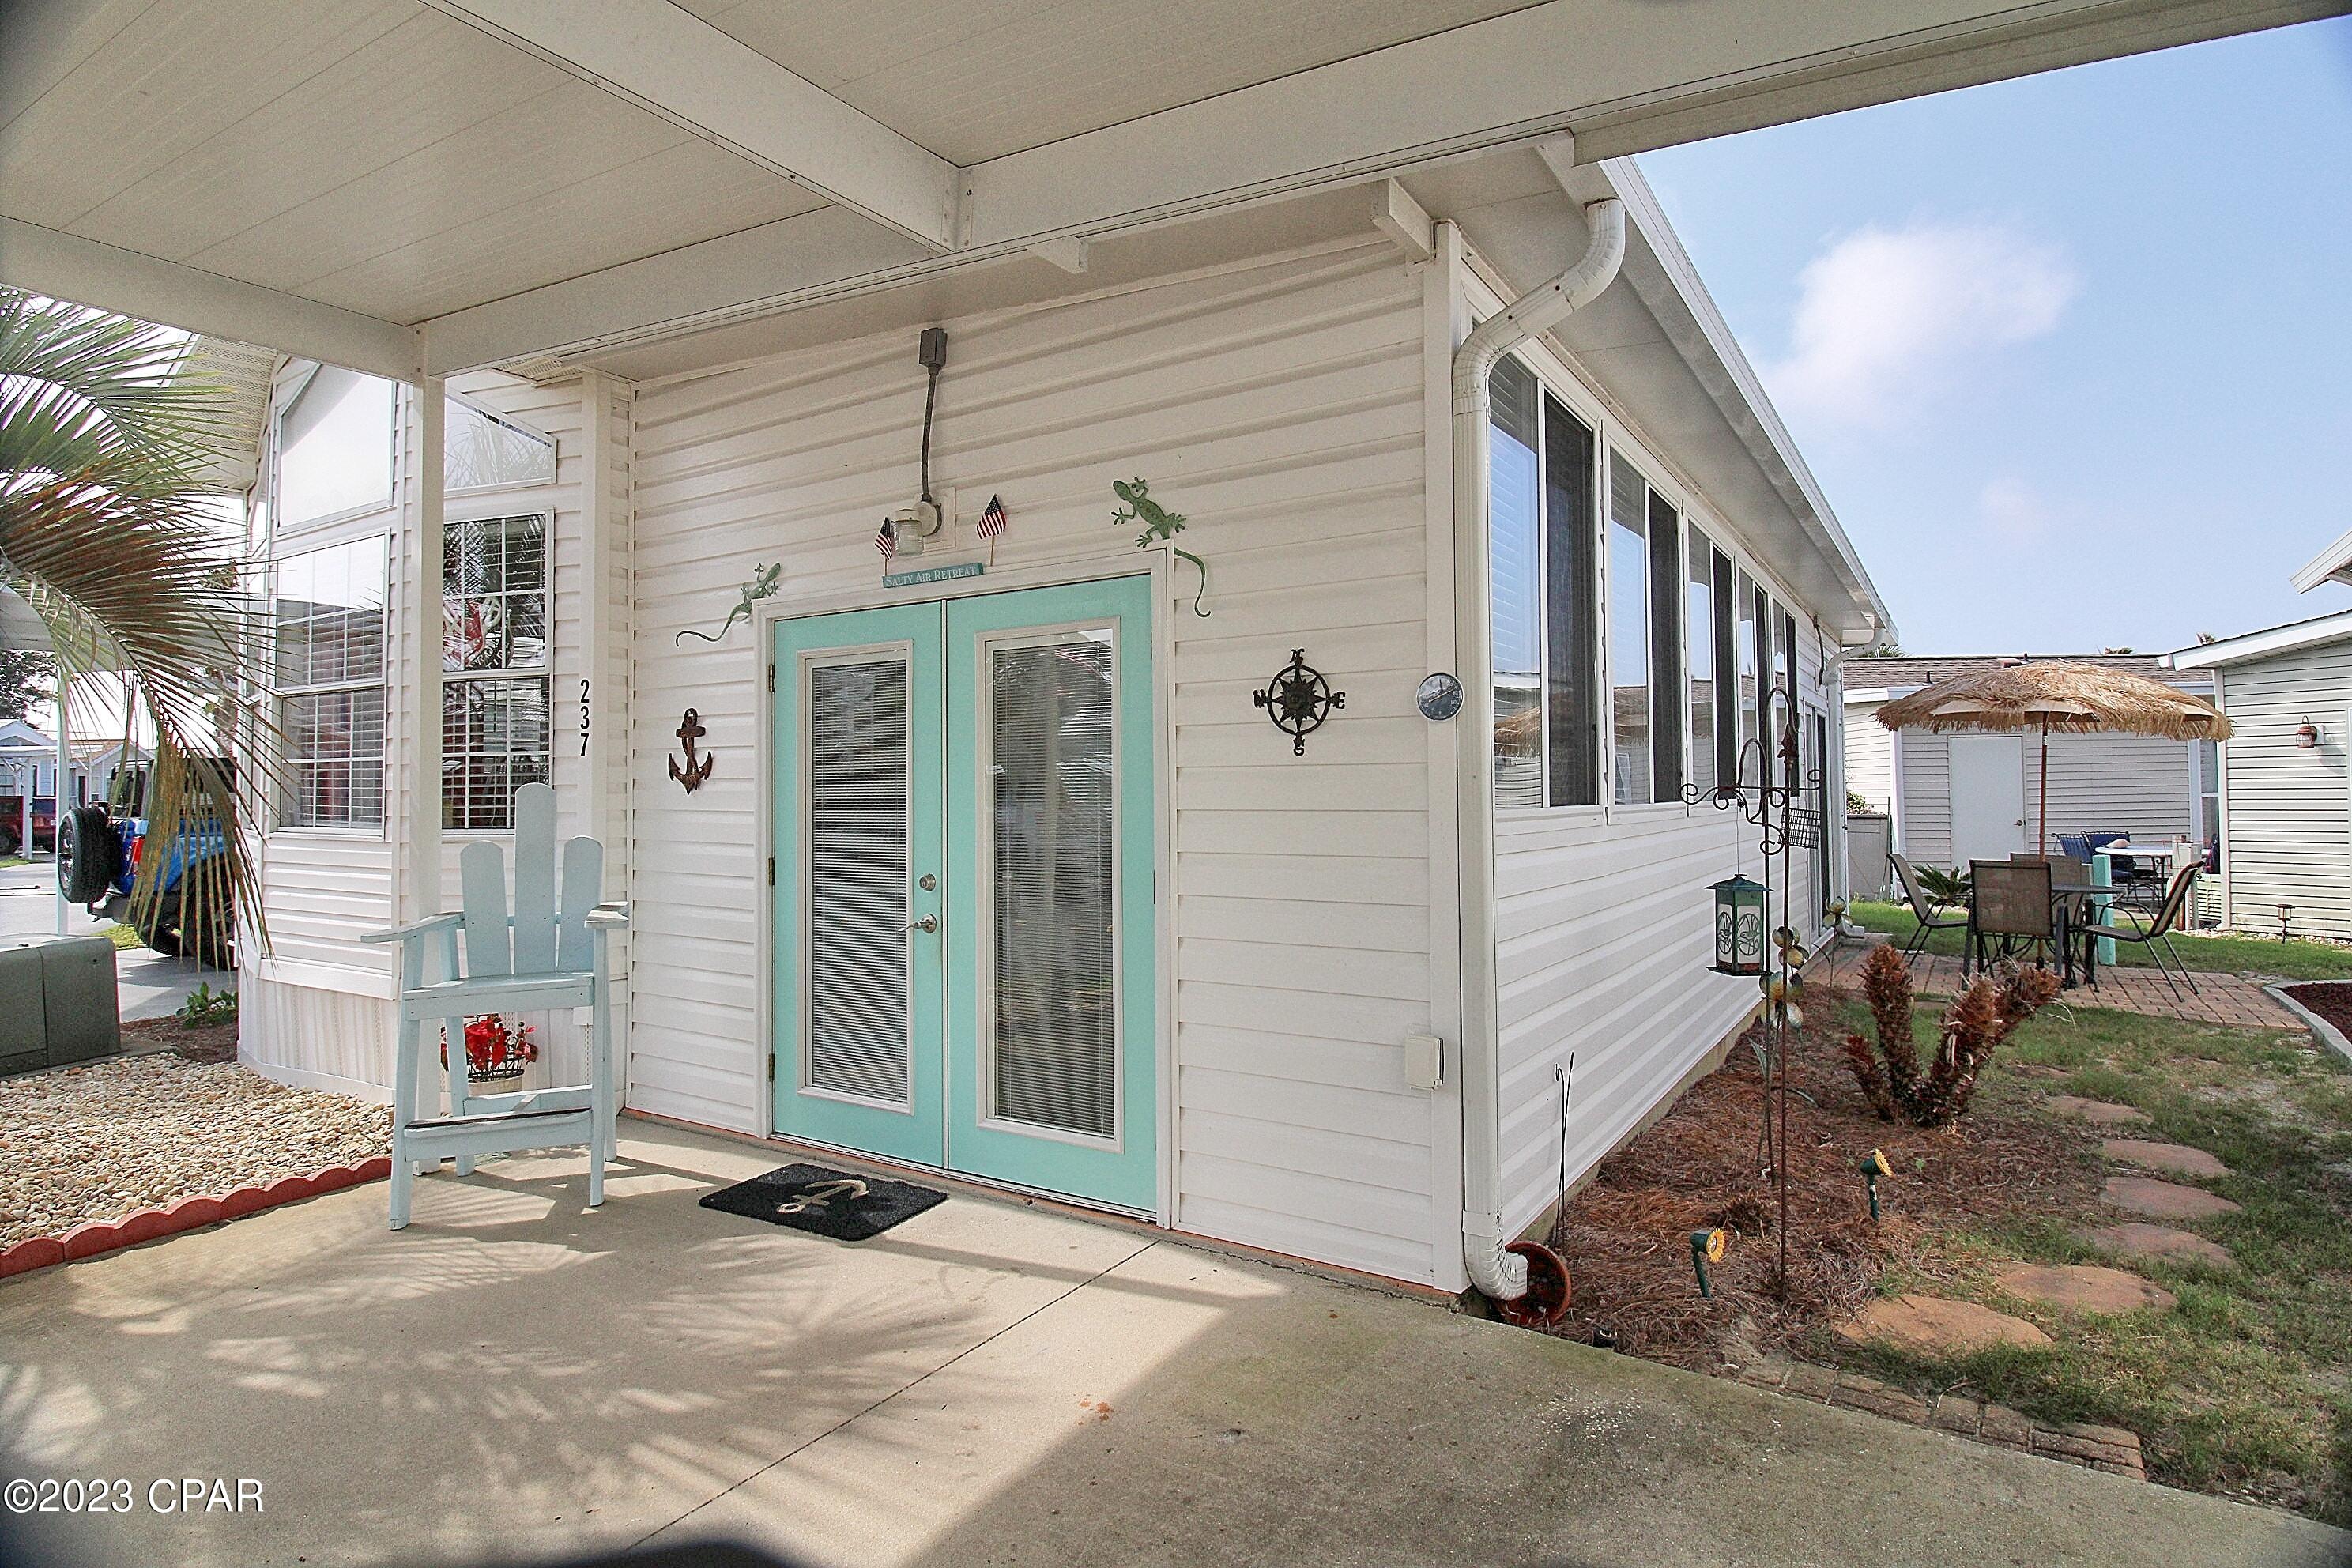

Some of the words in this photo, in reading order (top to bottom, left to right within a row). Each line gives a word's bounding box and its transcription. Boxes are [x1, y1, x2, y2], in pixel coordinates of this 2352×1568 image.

[885, 575, 912, 586] SALTY
[915, 572, 931, 582] AIR
[934, 566, 975, 580] RETREAT
[580, 679, 590, 756] 237
